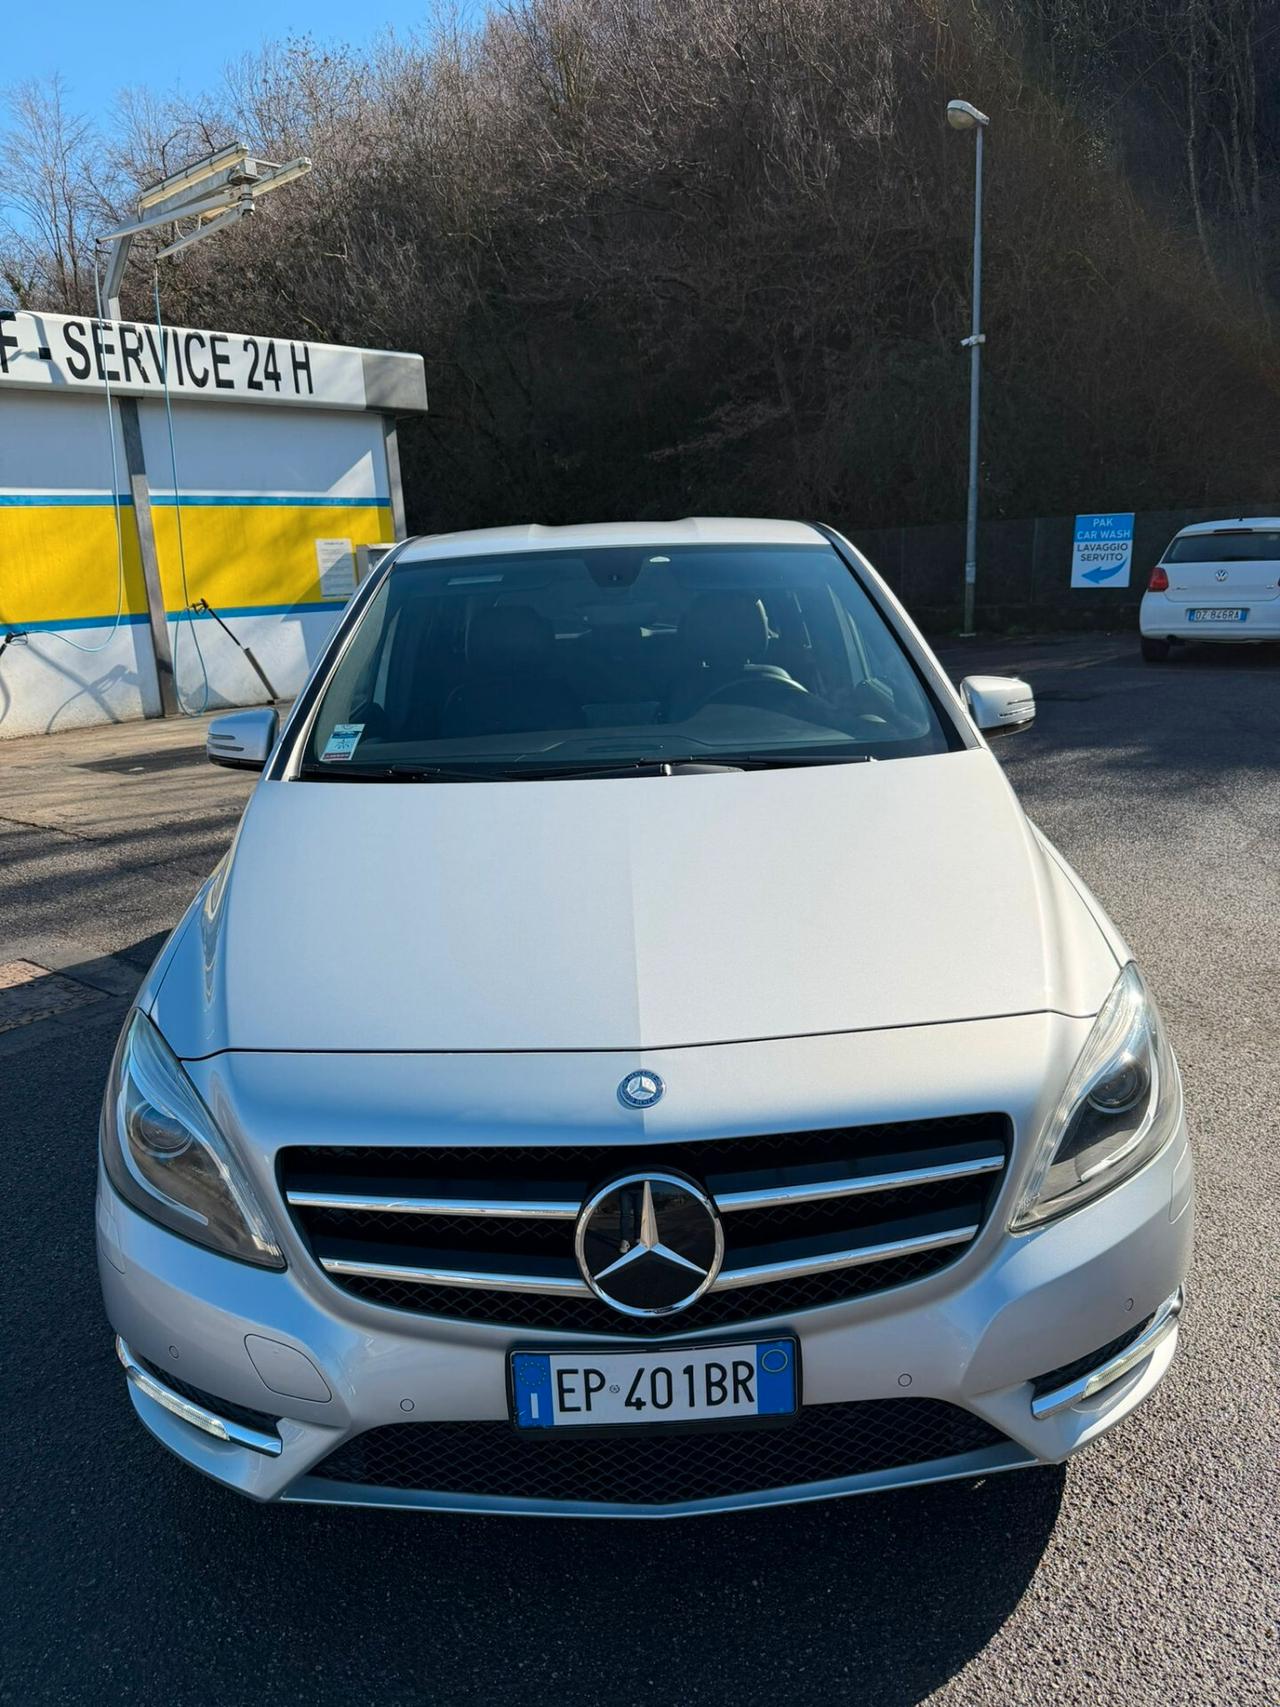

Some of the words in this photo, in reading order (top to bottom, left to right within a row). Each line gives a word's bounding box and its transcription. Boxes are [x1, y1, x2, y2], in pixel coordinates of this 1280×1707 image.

[62, 320, 235, 388] SERVICE
[243, 337, 282, 392] 24
[289, 341, 314, 394] H
[1093, 518, 1113, 527] PAK
[1077, 530, 1097, 539] CAR
[1100, 529, 1130, 538] WASH
[1077, 543, 1128, 552] LAVAGGIO
[1080, 553, 1123, 561] SERVITO
[556, 1368, 606, 1412] EP
[624, 1360, 755, 1410] 401BR
